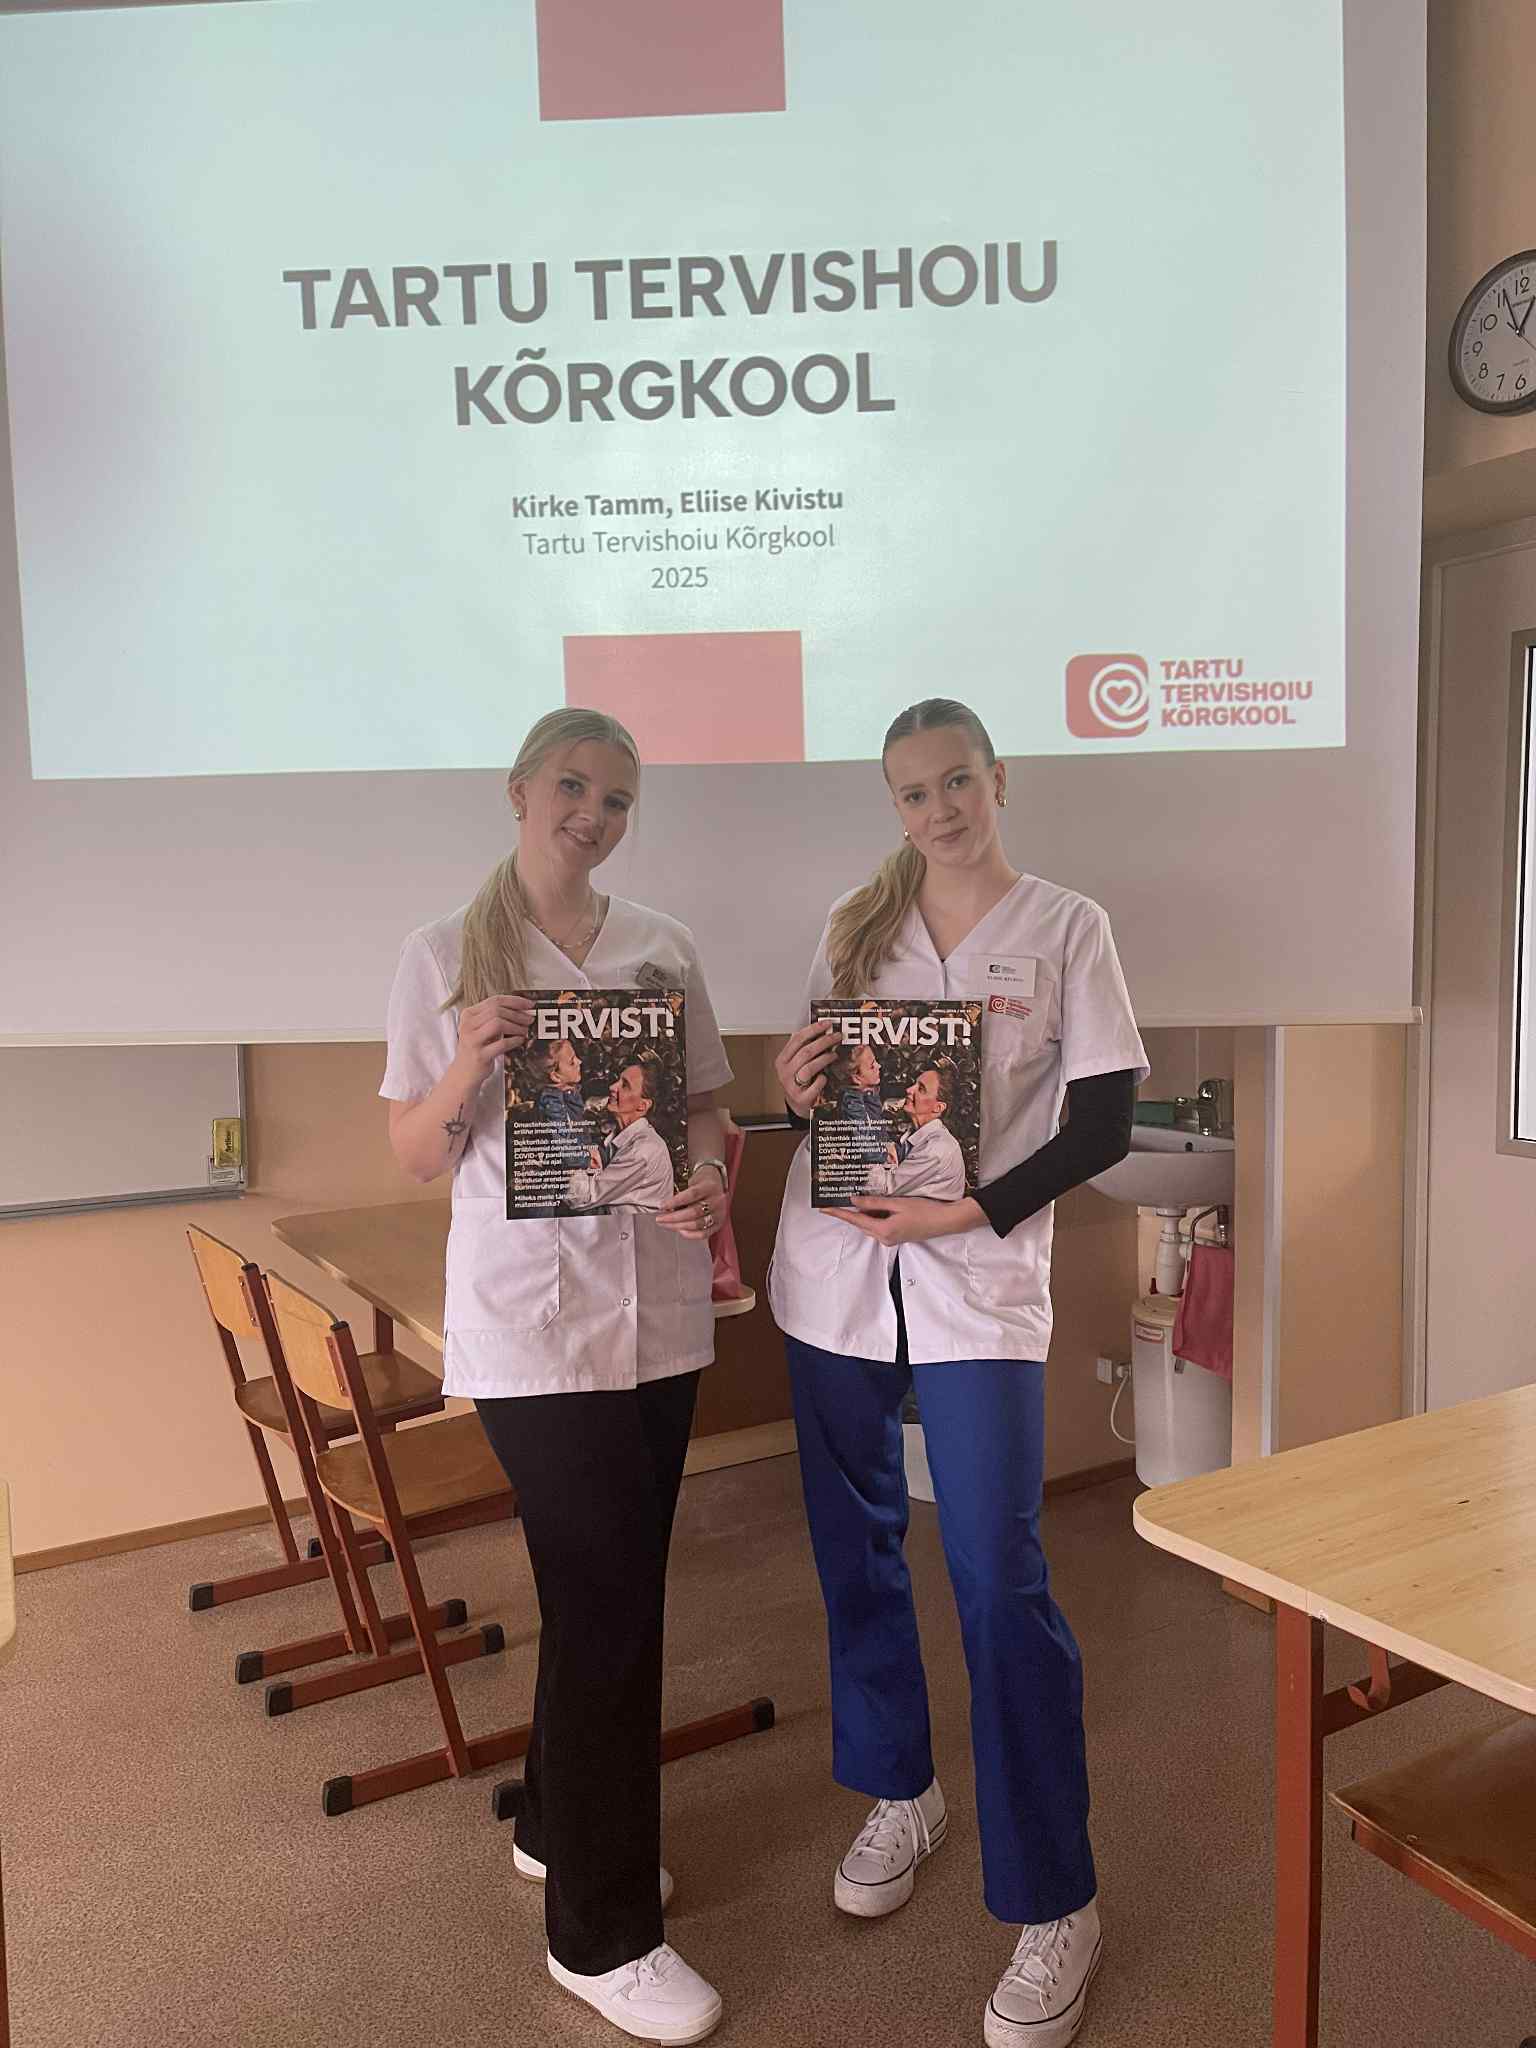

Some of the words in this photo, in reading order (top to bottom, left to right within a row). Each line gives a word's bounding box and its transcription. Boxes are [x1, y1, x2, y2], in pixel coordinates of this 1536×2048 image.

[283, 262, 548, 330] TARTU
[574, 240, 1058, 321] TERVISHOIU
[1514, 276, 1529, 295] 12
[1479, 314, 1498, 334] 10
[1472, 340, 1484, 357] 9
[1478, 362, 1489, 380] 8
[1496, 373, 1505, 391] 7
[454, 347, 897, 427] KÕRGKOOL
[1514, 374, 1527, 391] 6
[511, 496, 579, 519] Kirke
[585, 494, 673, 519] Tamm,
[680, 490, 748, 513] Eliise
[755, 487, 844, 511] Kivistu
[522, 533, 585, 555] Tartu
[592, 528, 718, 553] Tervishoiu
[726, 523, 836, 555] Kõrgkool
[650, 566, 709, 589] 2025
[1160, 659, 1243, 680] TARTU
[1160, 681, 1313, 703] TERVISHOIU
[1160, 704, 1297, 728] KÕRGKOOL
[527, 1006, 675, 1040] ERVIST!
